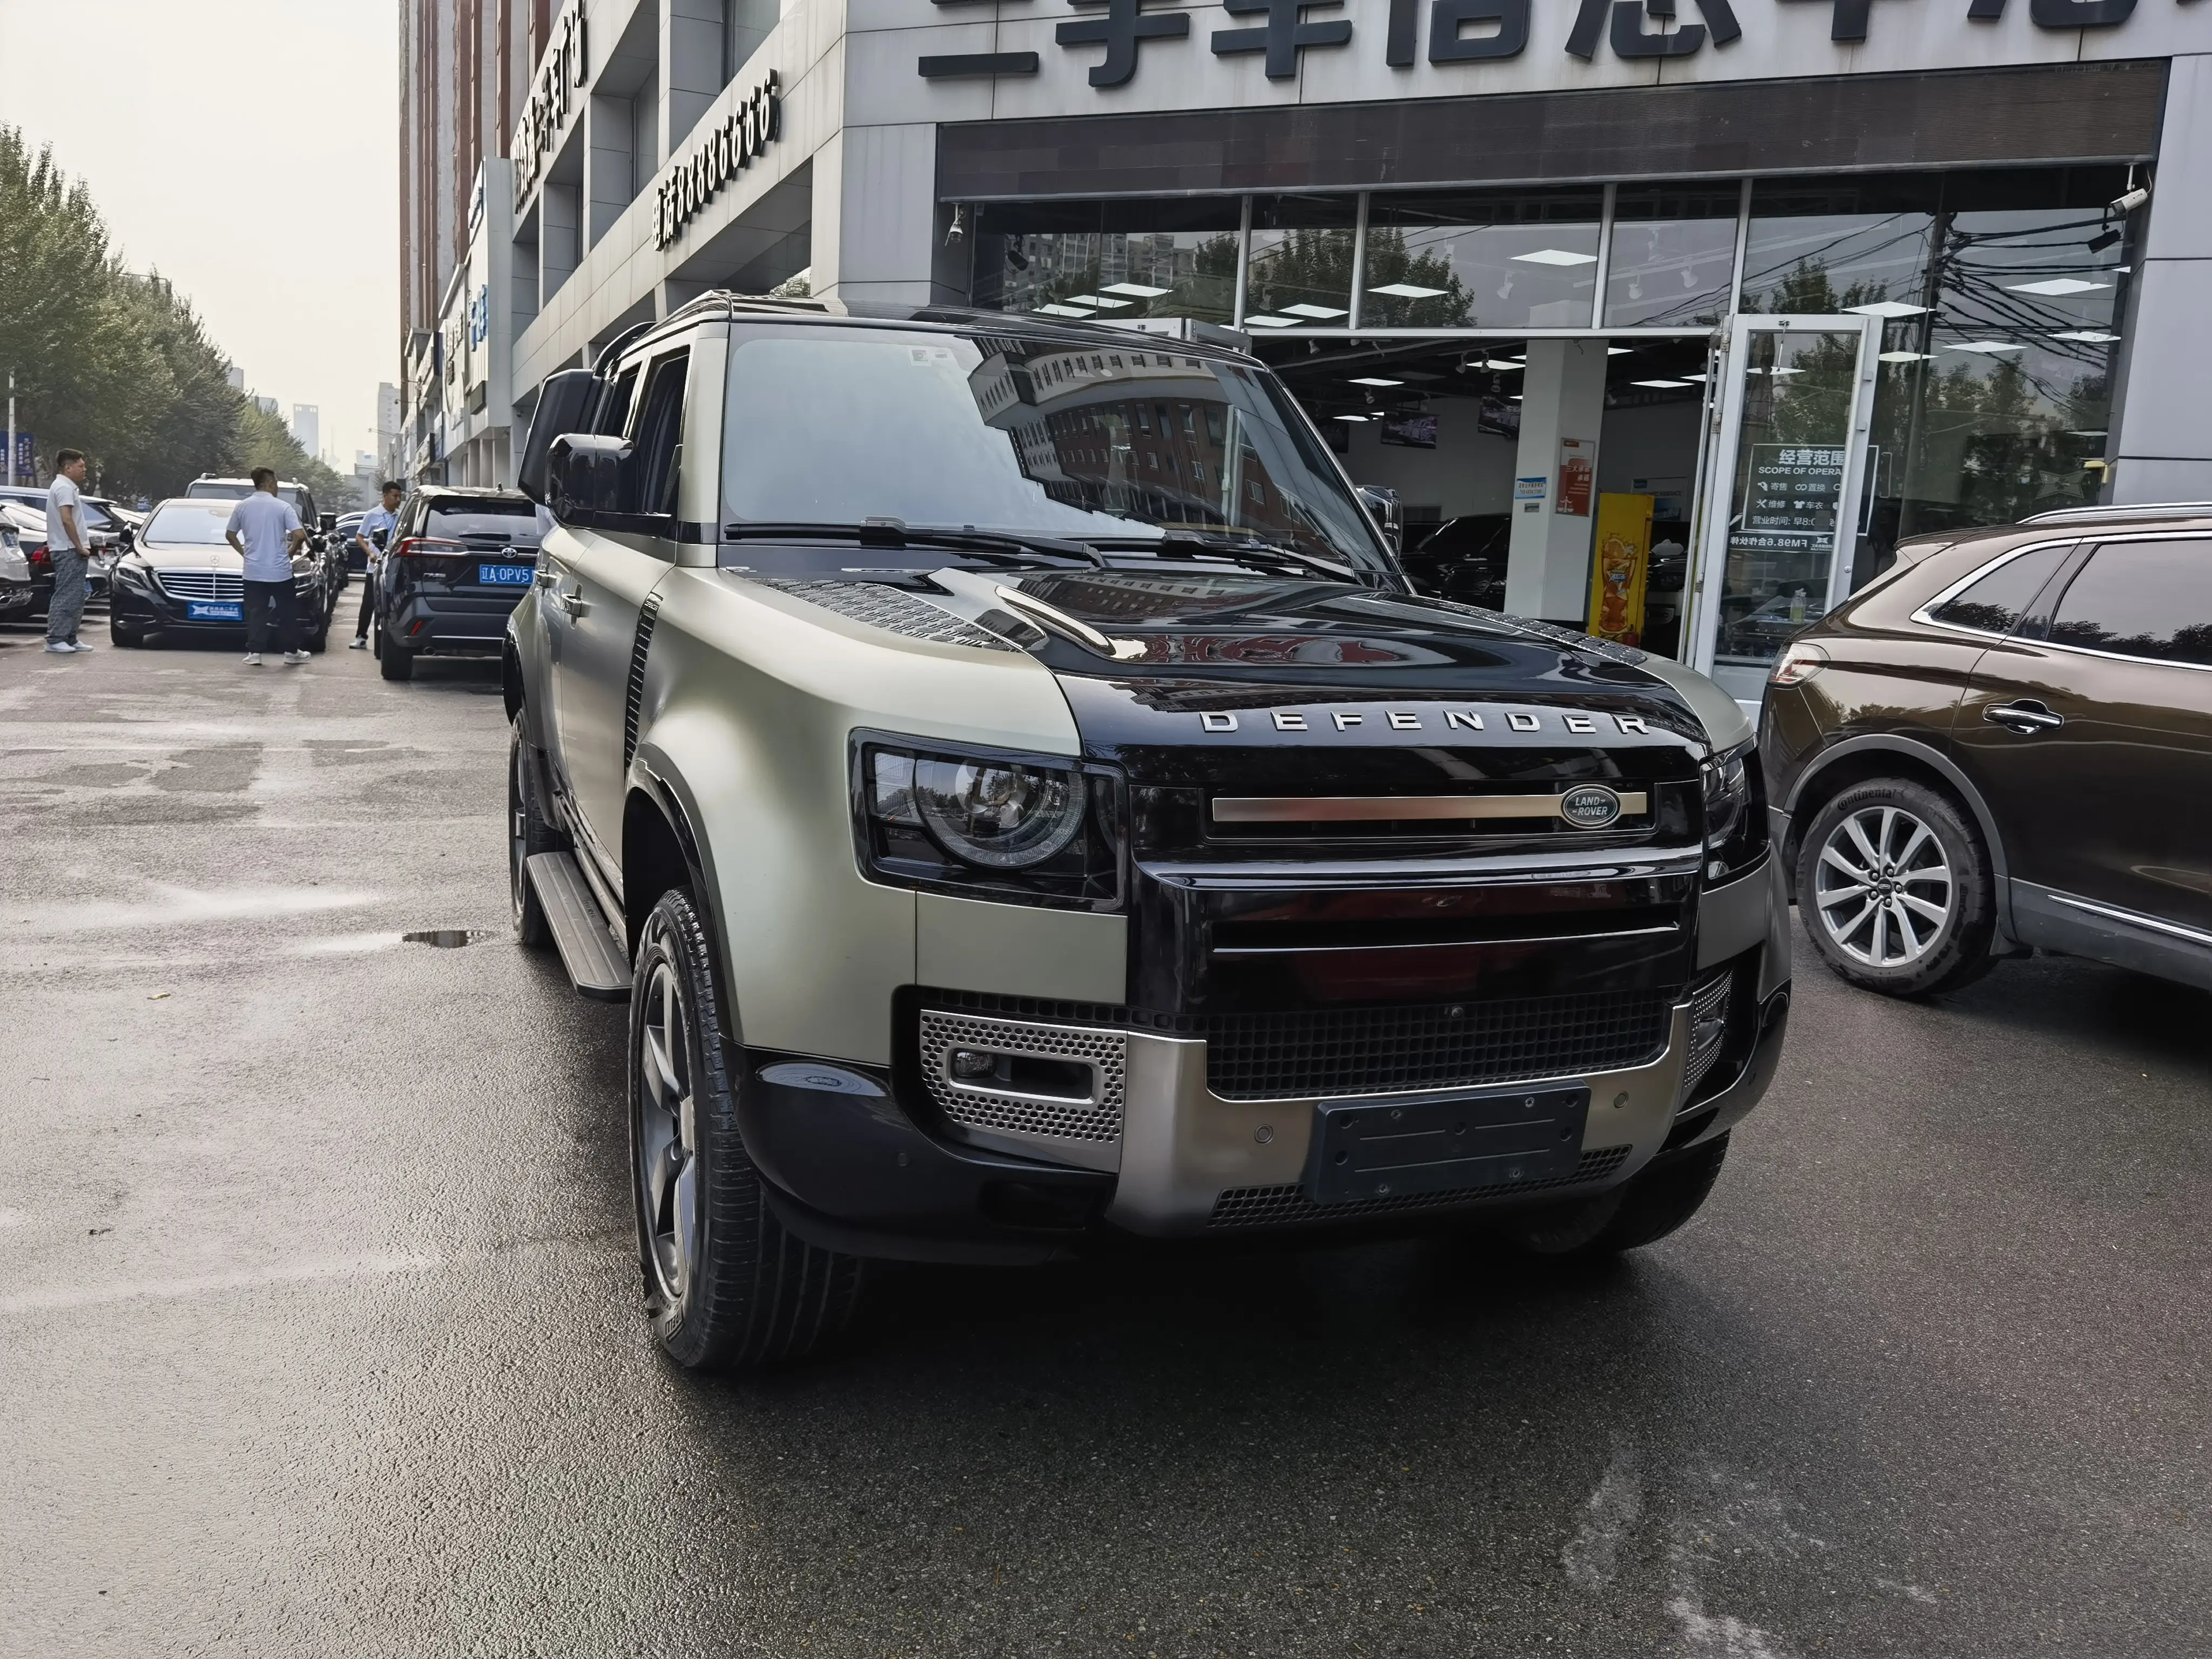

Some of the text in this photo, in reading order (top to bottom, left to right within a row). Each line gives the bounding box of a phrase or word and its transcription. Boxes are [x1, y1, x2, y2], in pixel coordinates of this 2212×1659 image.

[652, 68, 778, 252] 电话88886666
[1778, 449, 1845, 466] 经营范围
[1770, 482, 1825, 492] 寄售 置换
[1768, 500, 1824, 509] 维修 车衣
[1199, 709, 1650, 735] DEFENDER
[1575, 797, 1600, 806] LAND
[1577, 806, 1608, 816] ROVER
